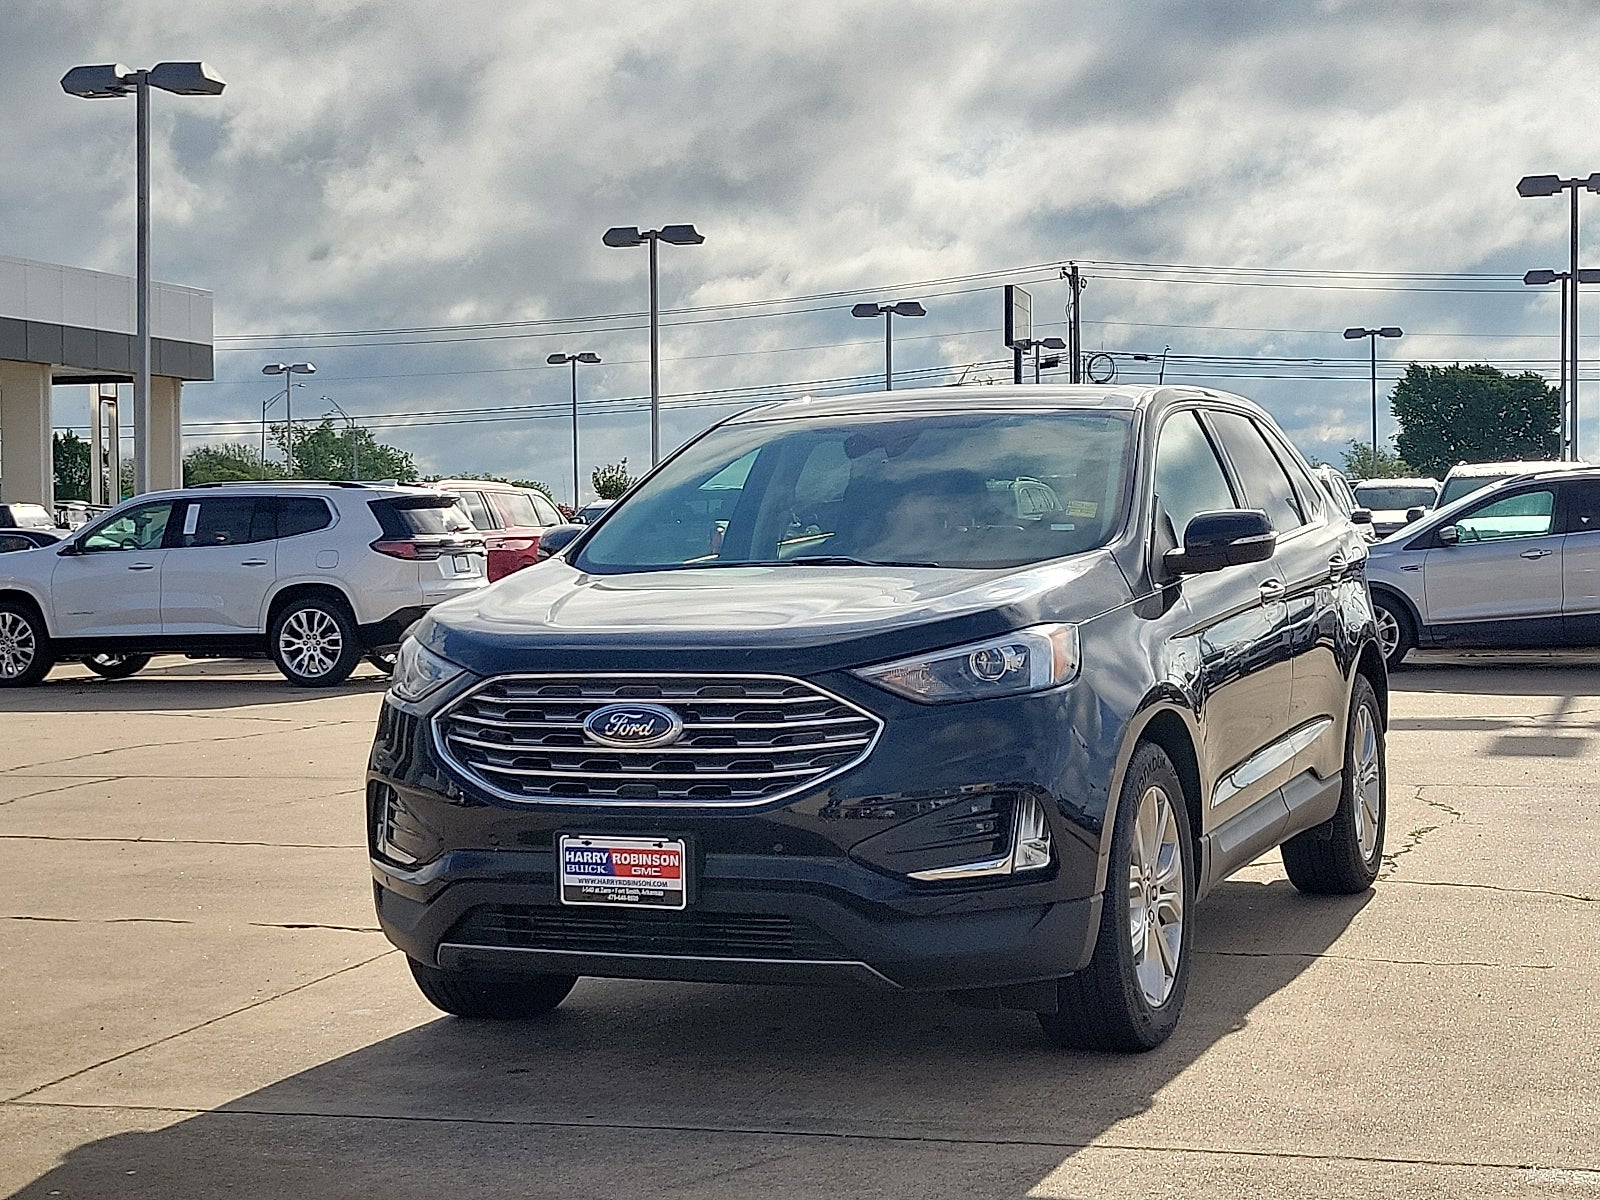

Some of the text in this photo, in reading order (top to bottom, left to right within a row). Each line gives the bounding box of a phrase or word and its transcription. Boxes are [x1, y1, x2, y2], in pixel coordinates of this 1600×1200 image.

[604, 713, 655, 736] Ford
[566, 851, 679, 866] HARRY ROBINSON
[566, 864, 662, 876] BUICK GMC
[577, 878, 668, 888] WWW.HARRYROBINSON.COM
